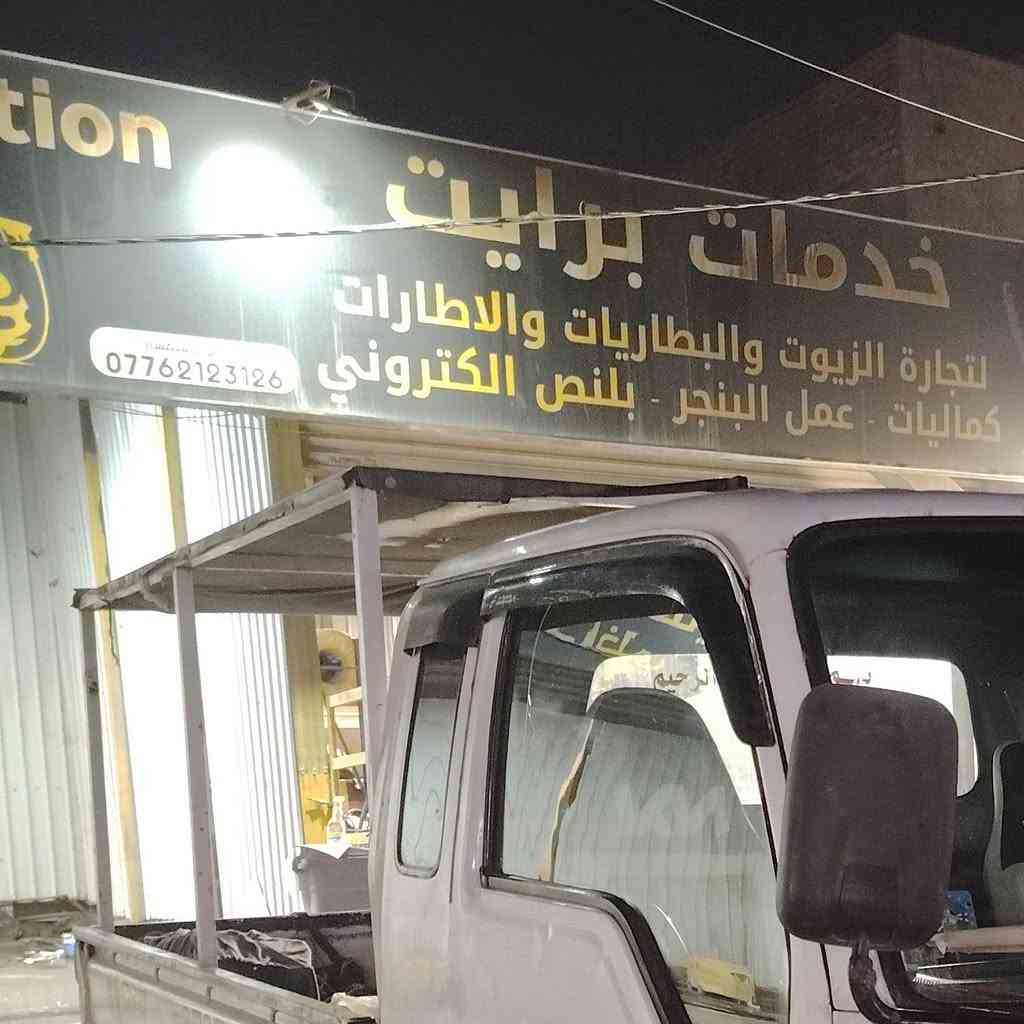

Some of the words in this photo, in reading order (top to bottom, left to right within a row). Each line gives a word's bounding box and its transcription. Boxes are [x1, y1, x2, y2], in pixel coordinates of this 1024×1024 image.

[0, 78, 172, 170] tion
[385, 155, 644, 289] برايت
[688, 206, 951, 309] خدمات
[333, 272, 546, 350] والاطارات
[563, 305, 764, 377] والبطاريات
[779, 336, 885, 387] الزيوت
[106, 351, 283, 389] 07762123126
[317, 339, 516, 410] الكتروني
[535, 366, 635, 421] بلنص
[899, 346, 988, 394] لتجارة
[671, 381, 769, 432] البنجر
[785, 389, 855, 437] عمل
[887, 400, 1001, 449] كماليات
